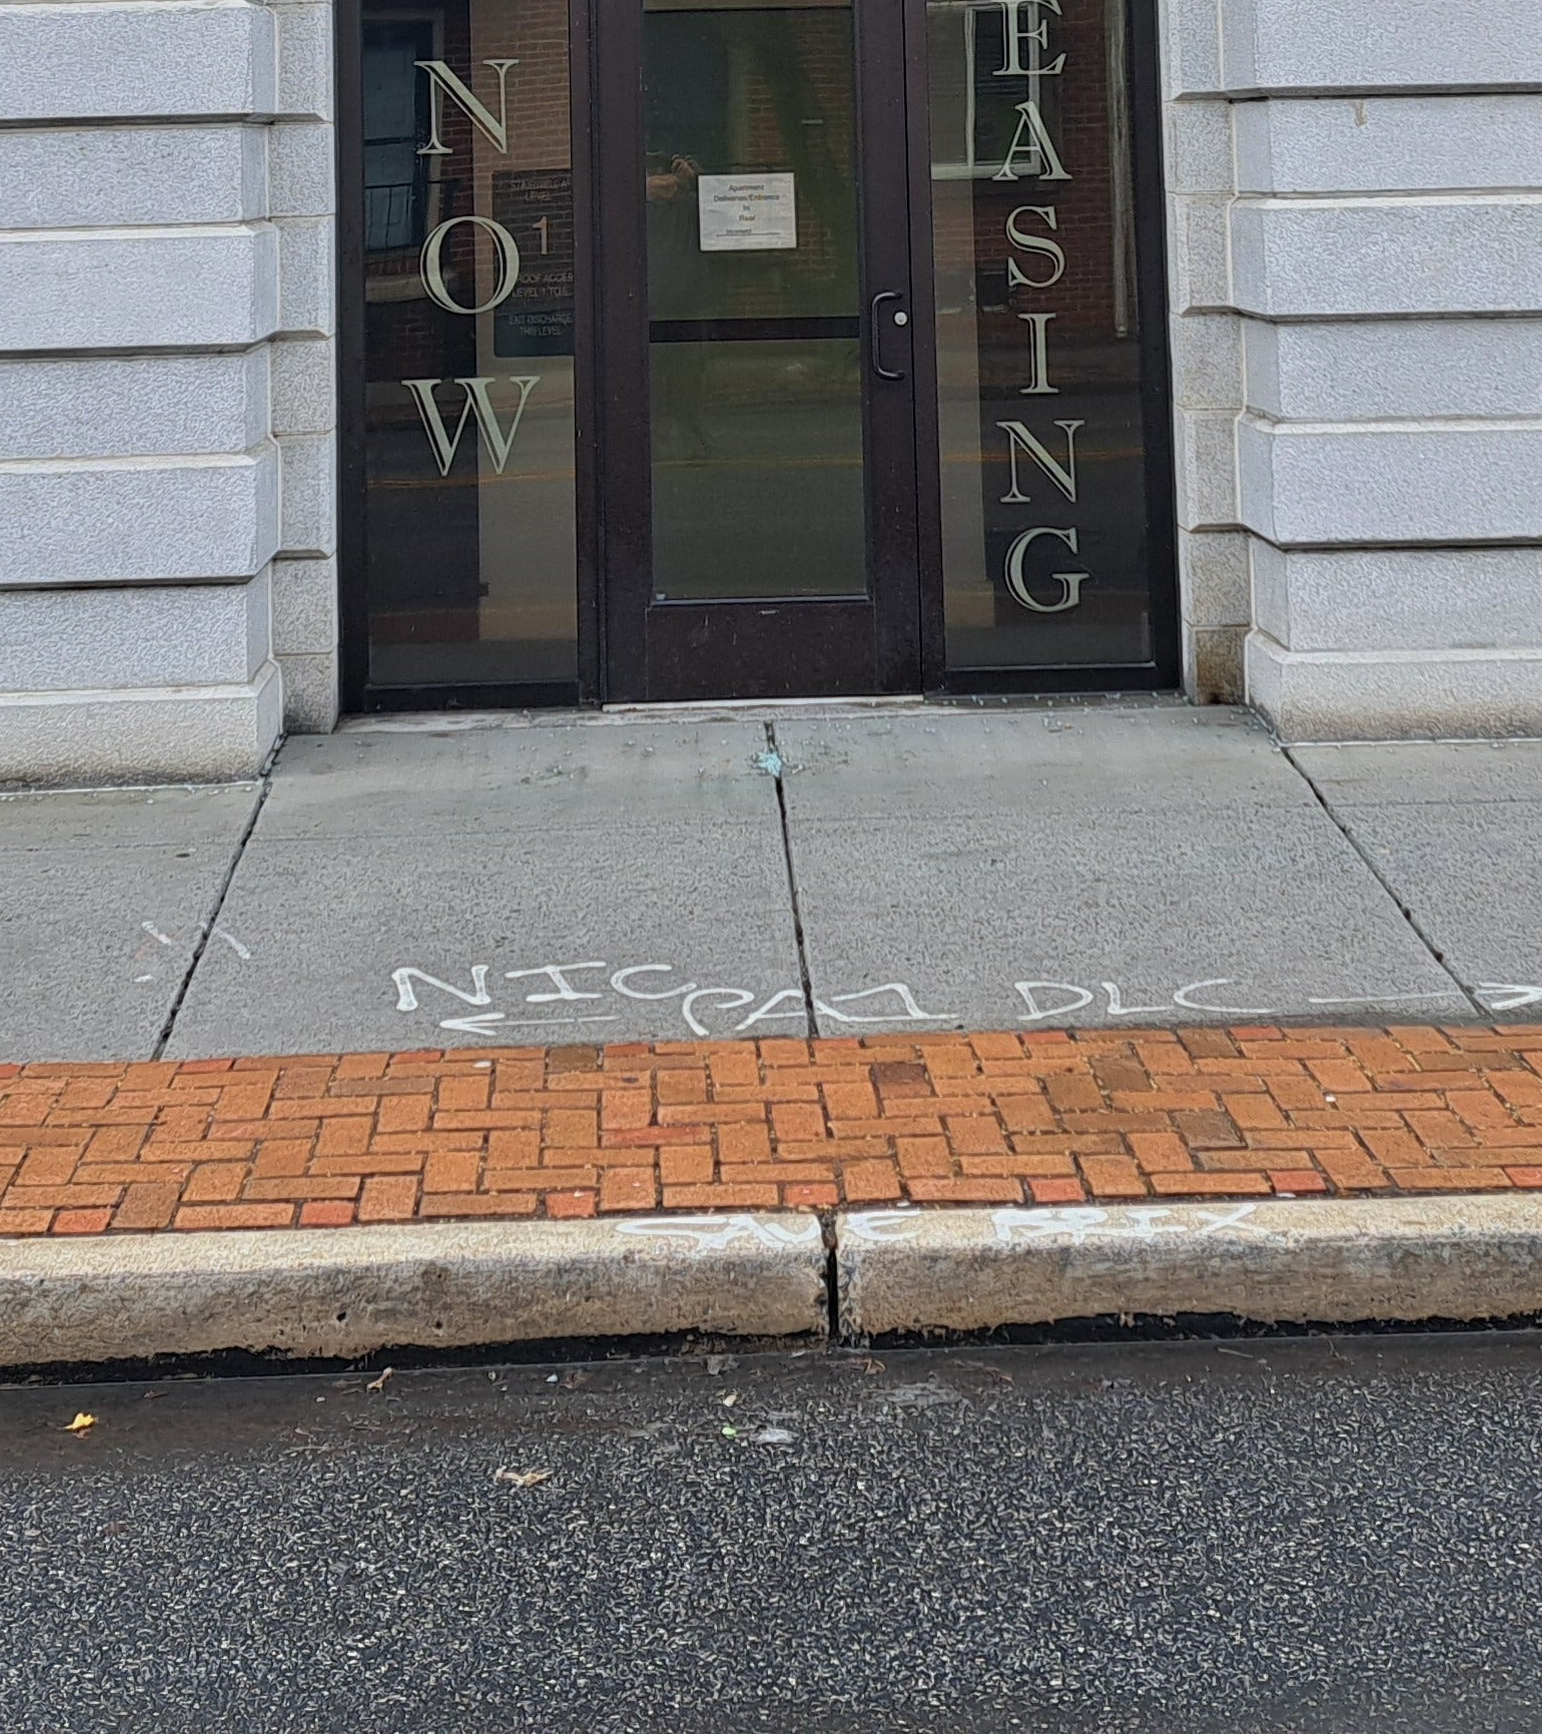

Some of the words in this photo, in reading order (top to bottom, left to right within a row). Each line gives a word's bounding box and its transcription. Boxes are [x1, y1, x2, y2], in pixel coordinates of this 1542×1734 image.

[525, 191, 551, 201] LEVEL
[532, 216, 549, 256] 1
[401, 58, 540, 478] NOW
[391, 961, 698, 1012] NIC
[1015, 978, 1275, 1022] DLC
